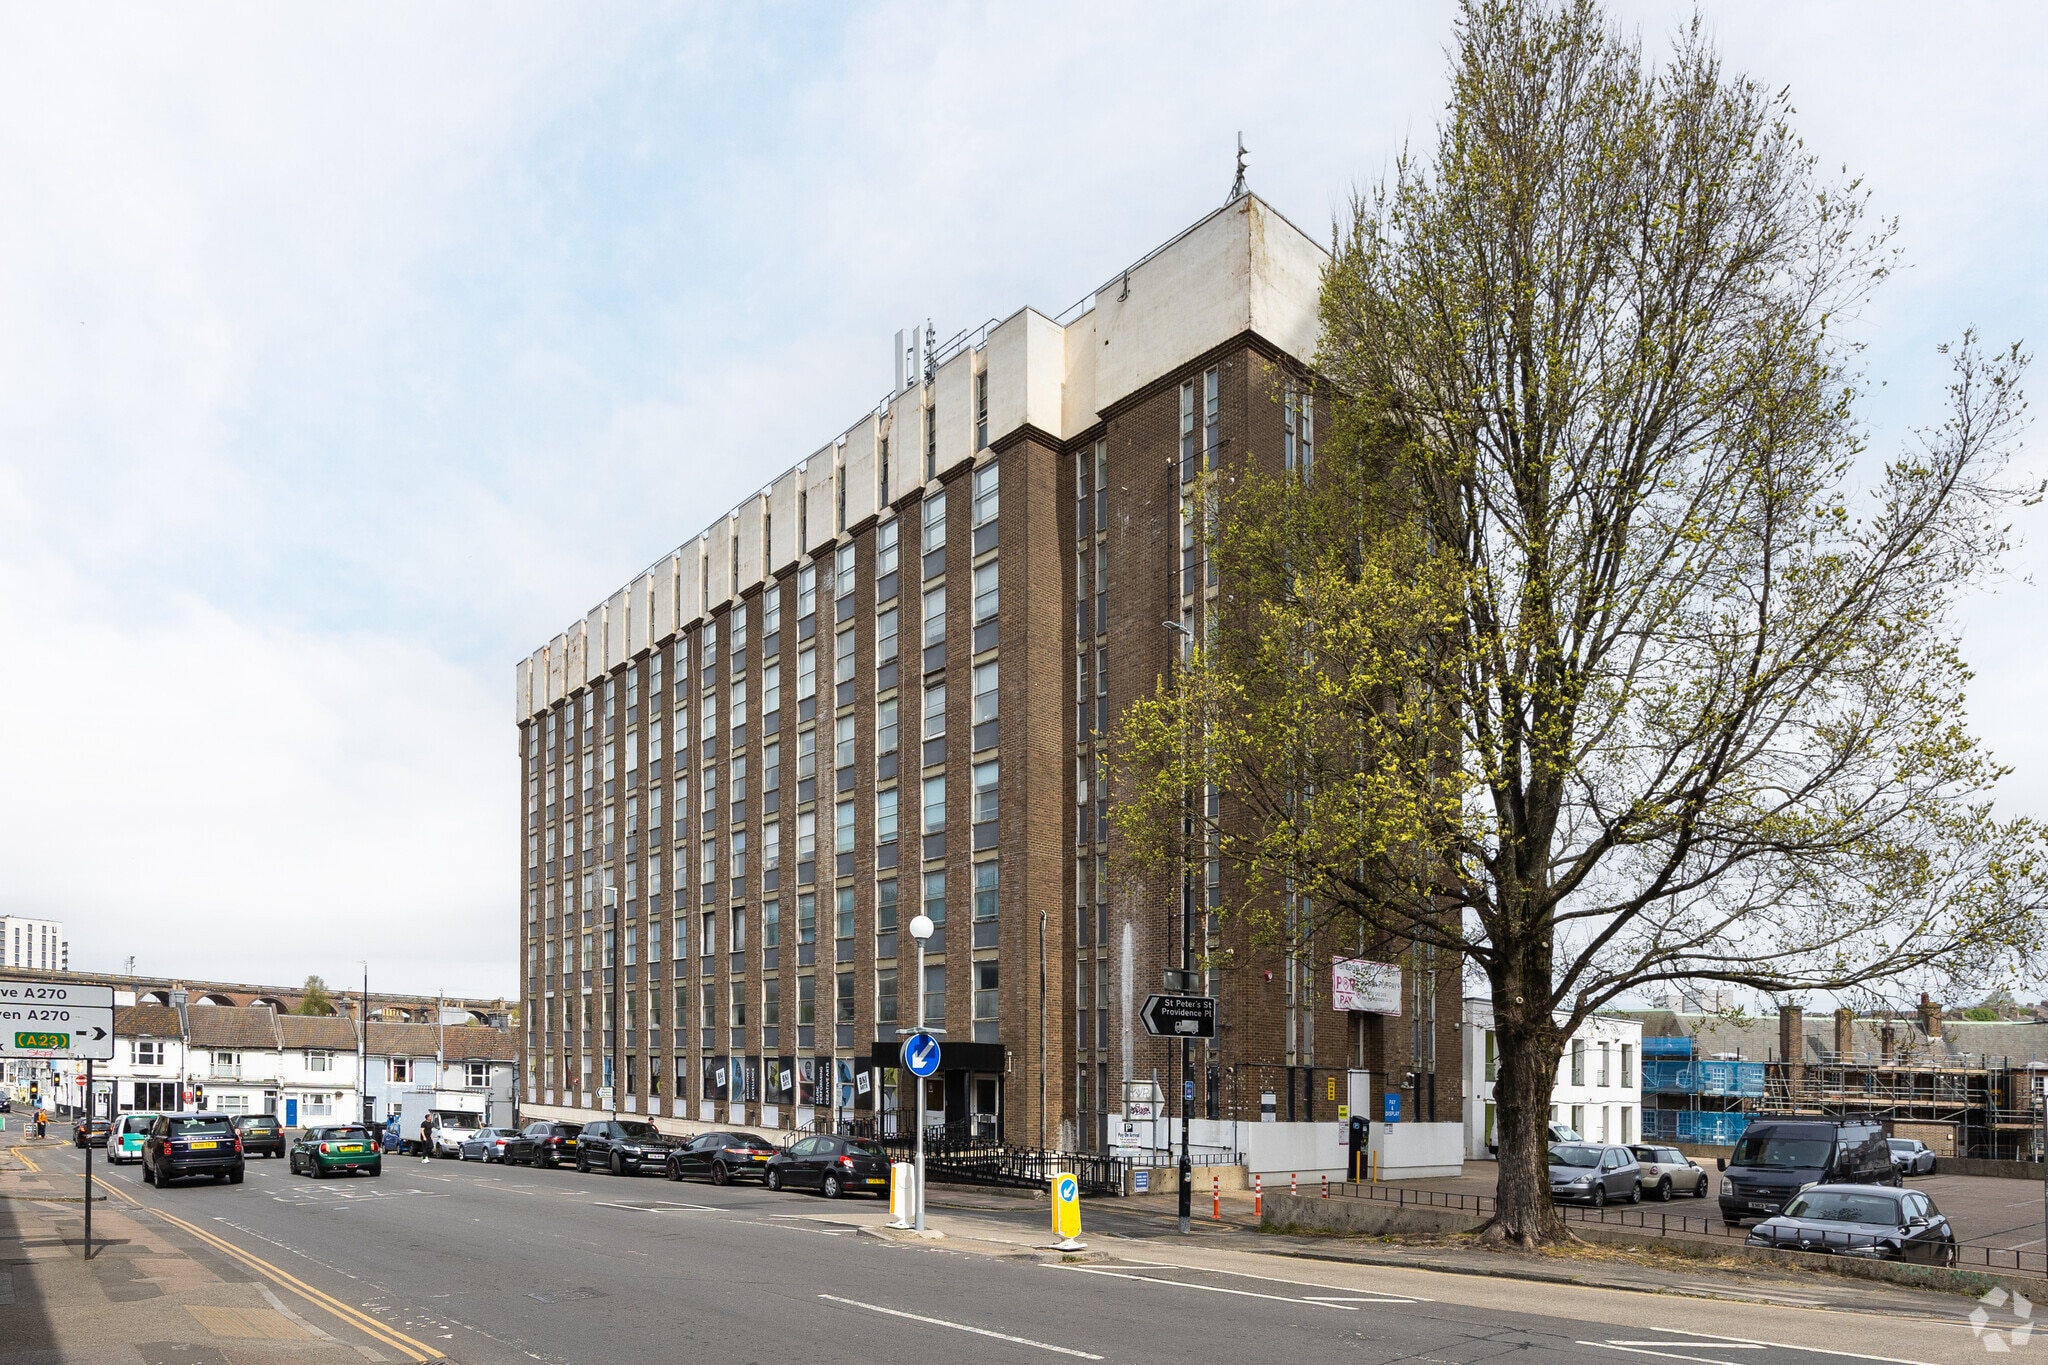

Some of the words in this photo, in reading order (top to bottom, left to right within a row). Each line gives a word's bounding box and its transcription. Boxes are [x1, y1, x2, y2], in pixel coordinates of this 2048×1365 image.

[24, 988, 67, 1000] A270
[1164, 999, 1174, 1007] St
[1176, 999, 1201, 1008] Peter's
[1203, 1001, 1212, 1009] St
[1340, 995, 1353, 1004] PAY
[0, 1011, 21, 1020] en
[27, 1010, 71, 1021] A270
[1161, 1008, 1202, 1017] Providence
[1204, 1010, 1212, 1018] Pl
